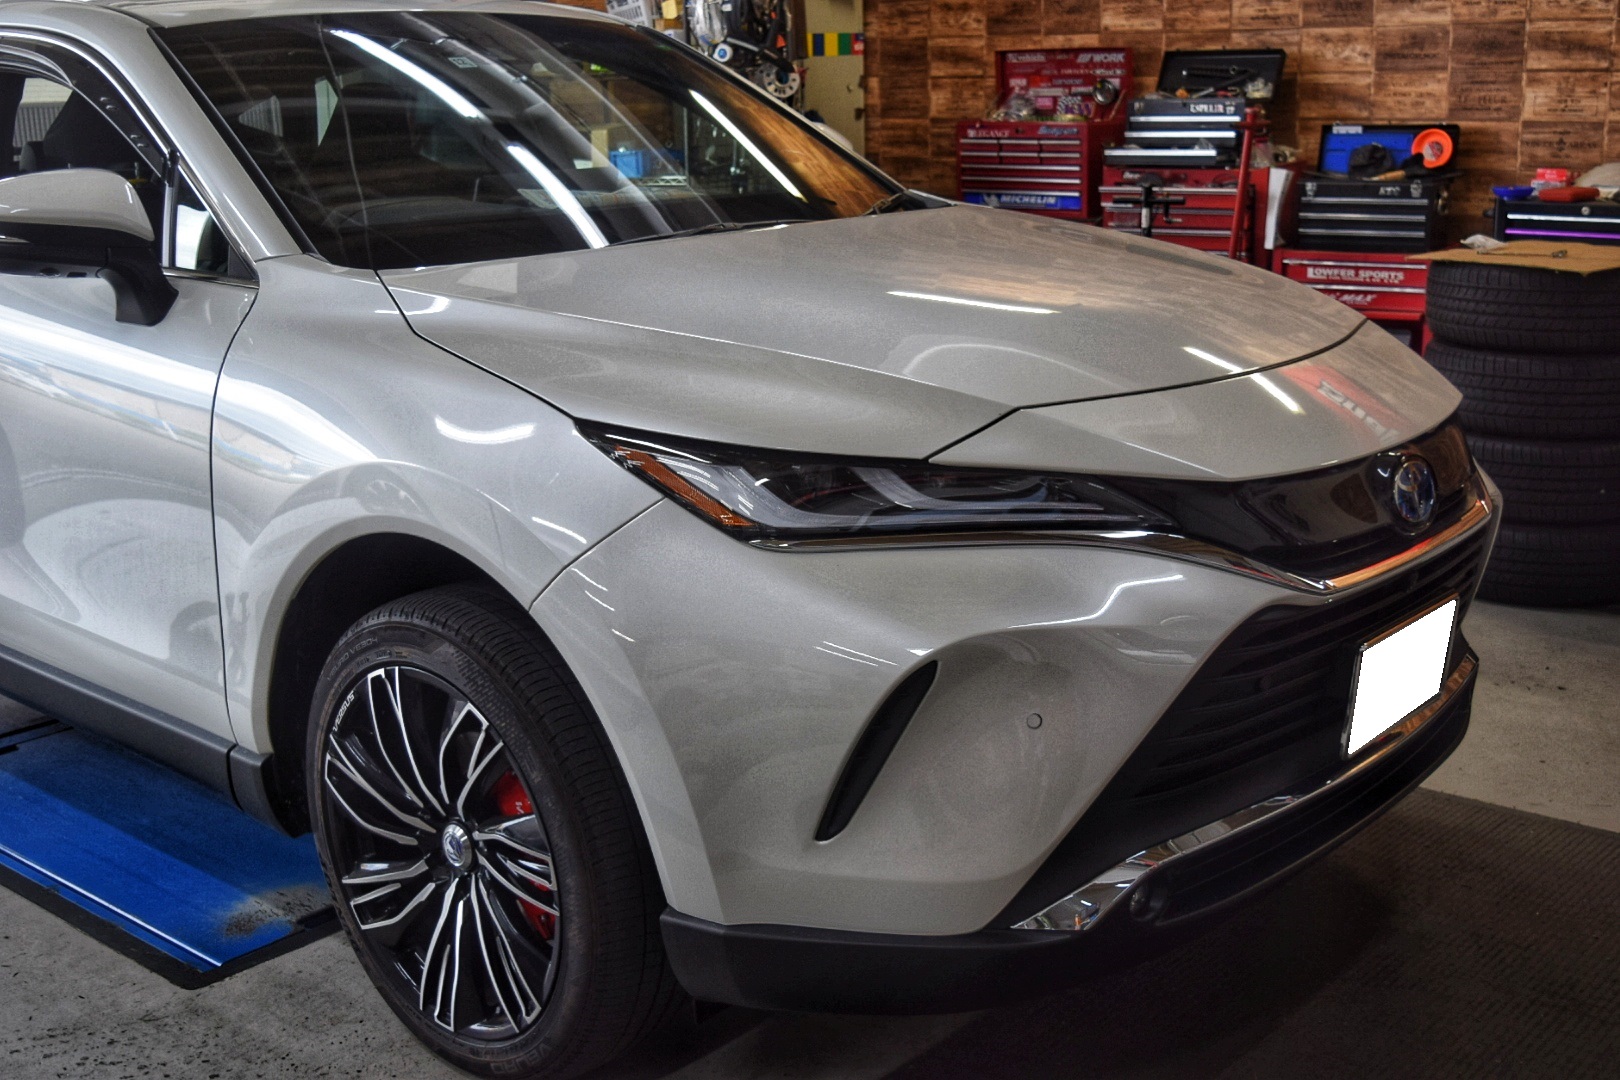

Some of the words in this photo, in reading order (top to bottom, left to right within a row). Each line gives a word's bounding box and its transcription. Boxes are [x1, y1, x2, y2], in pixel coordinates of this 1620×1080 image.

[1000, 194, 1057, 204] MICHELIN
[1358, 270, 1405, 281] SPORTS
[332, 690, 355, 732] VERSUS
